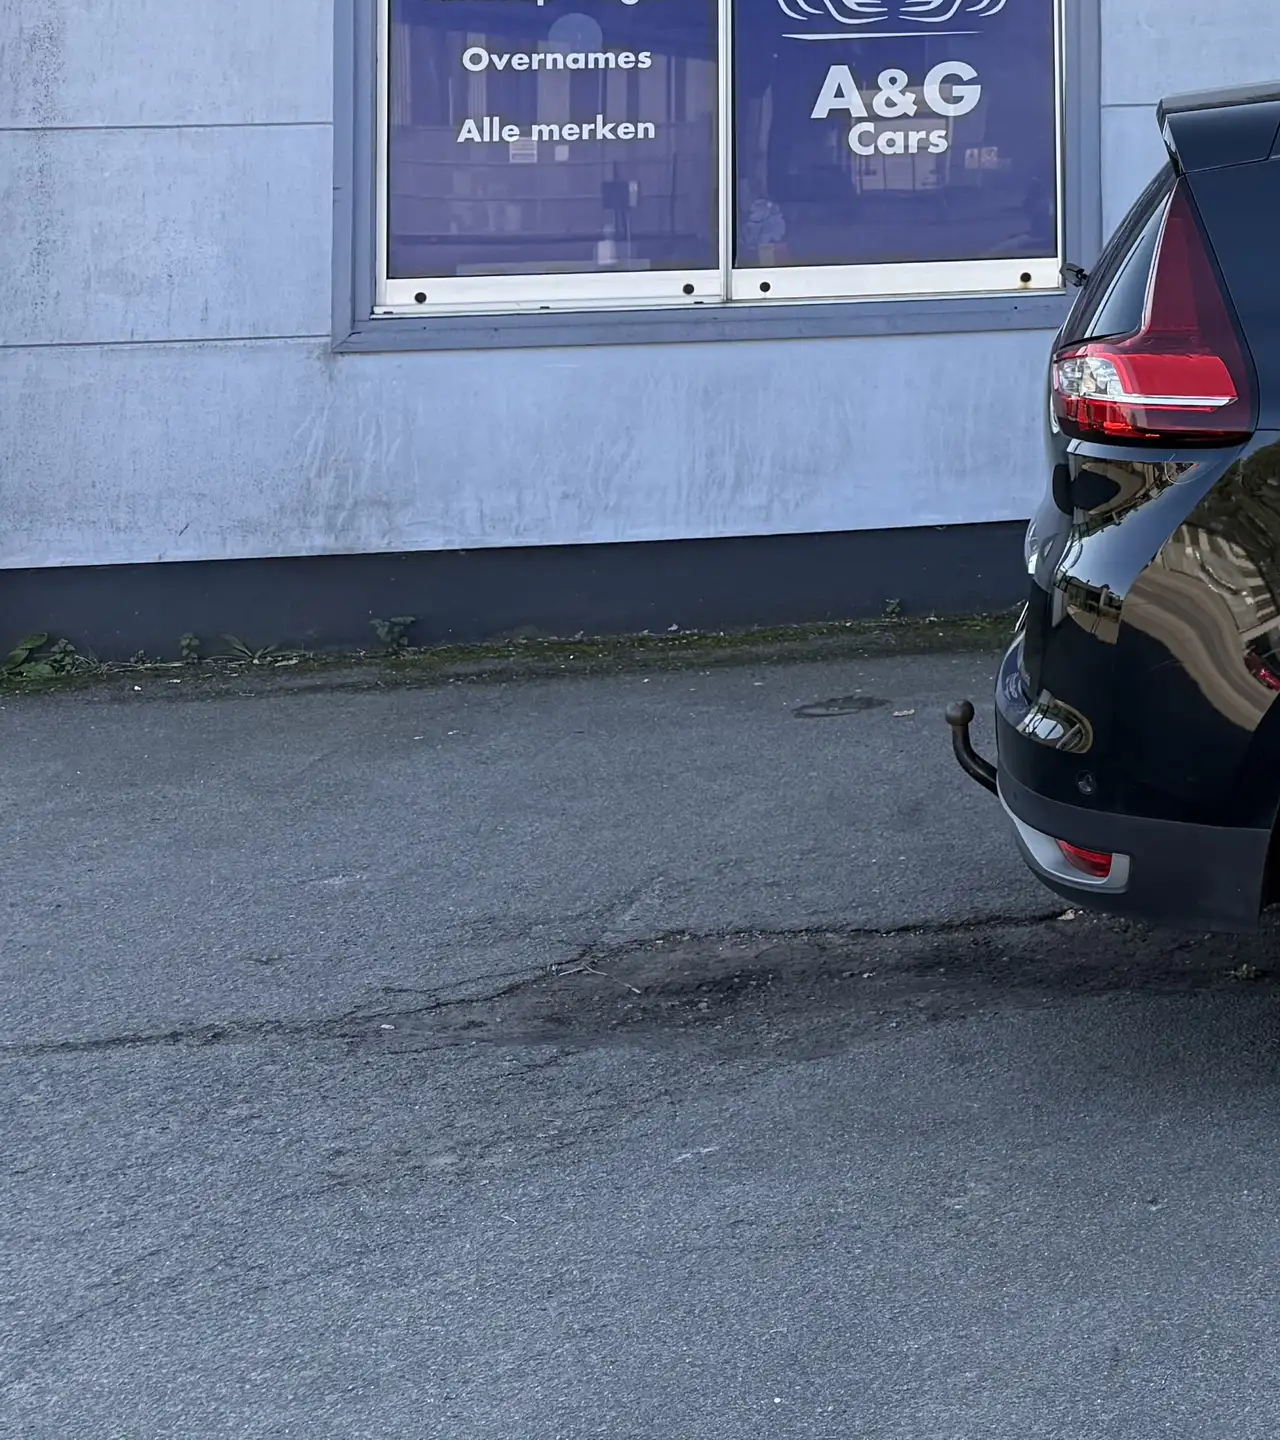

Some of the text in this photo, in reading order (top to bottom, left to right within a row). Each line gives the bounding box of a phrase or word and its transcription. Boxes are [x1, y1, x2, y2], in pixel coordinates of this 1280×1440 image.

[462, 46, 652, 72] Overnames
[810, 60, 982, 119] A&G
[456, 115, 655, 143] Alle merken
[848, 121, 948, 156] Cars
